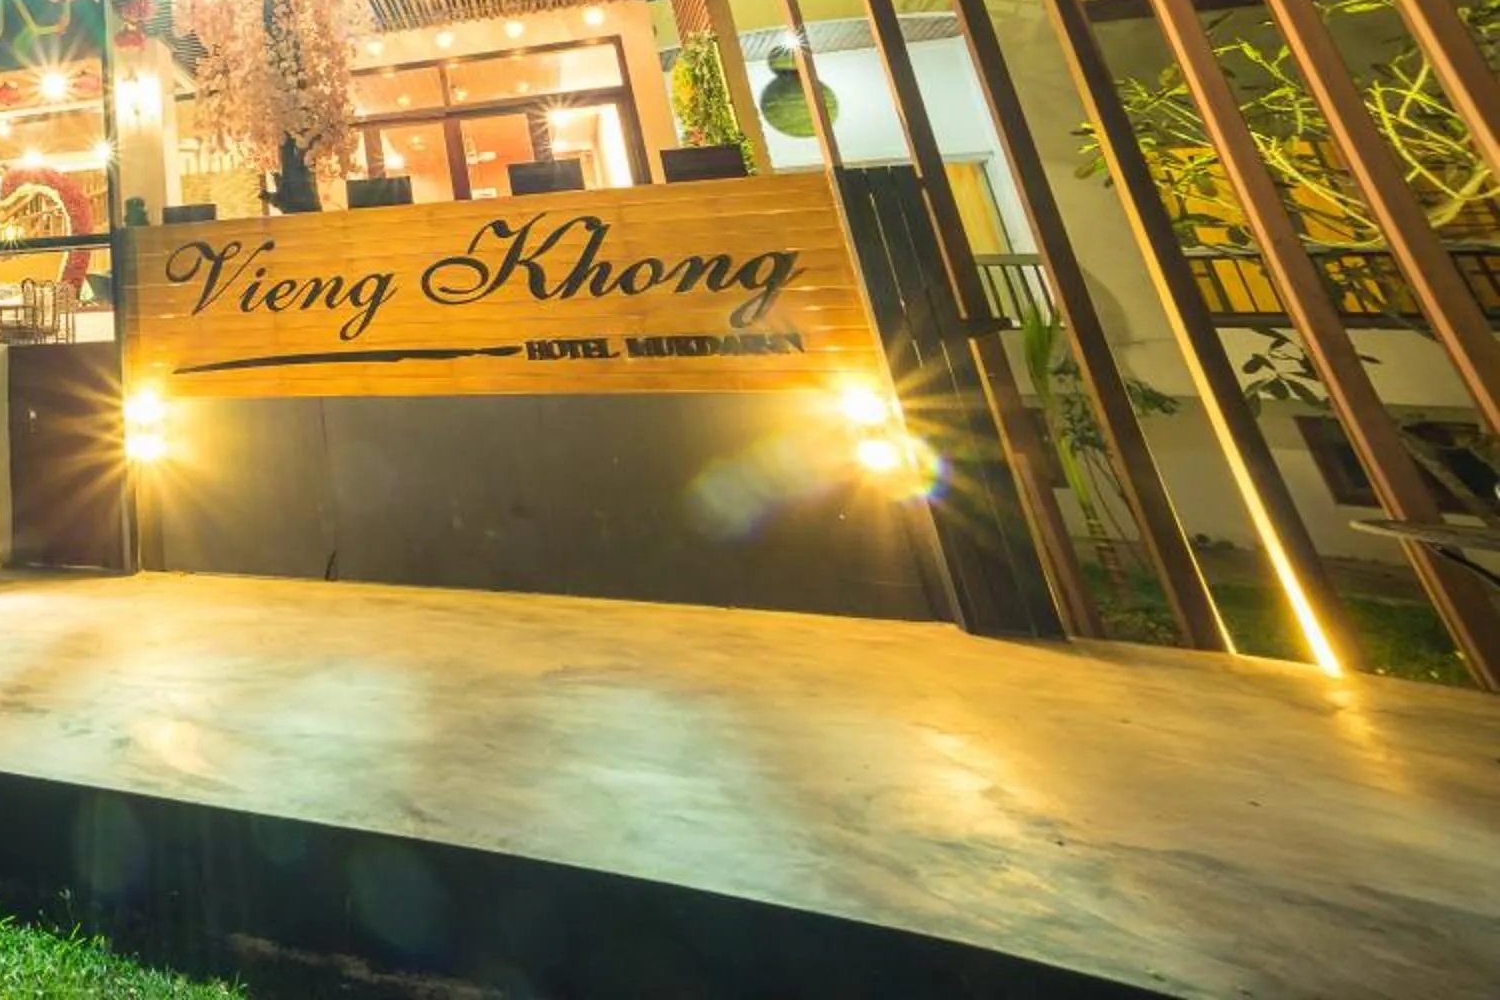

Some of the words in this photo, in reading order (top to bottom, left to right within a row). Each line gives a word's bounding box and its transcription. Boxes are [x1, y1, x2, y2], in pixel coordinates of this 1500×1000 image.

[165, 240, 398, 341] Vieng
[421, 213, 806, 328] Khong
[523, 336, 620, 361] HOTEL
